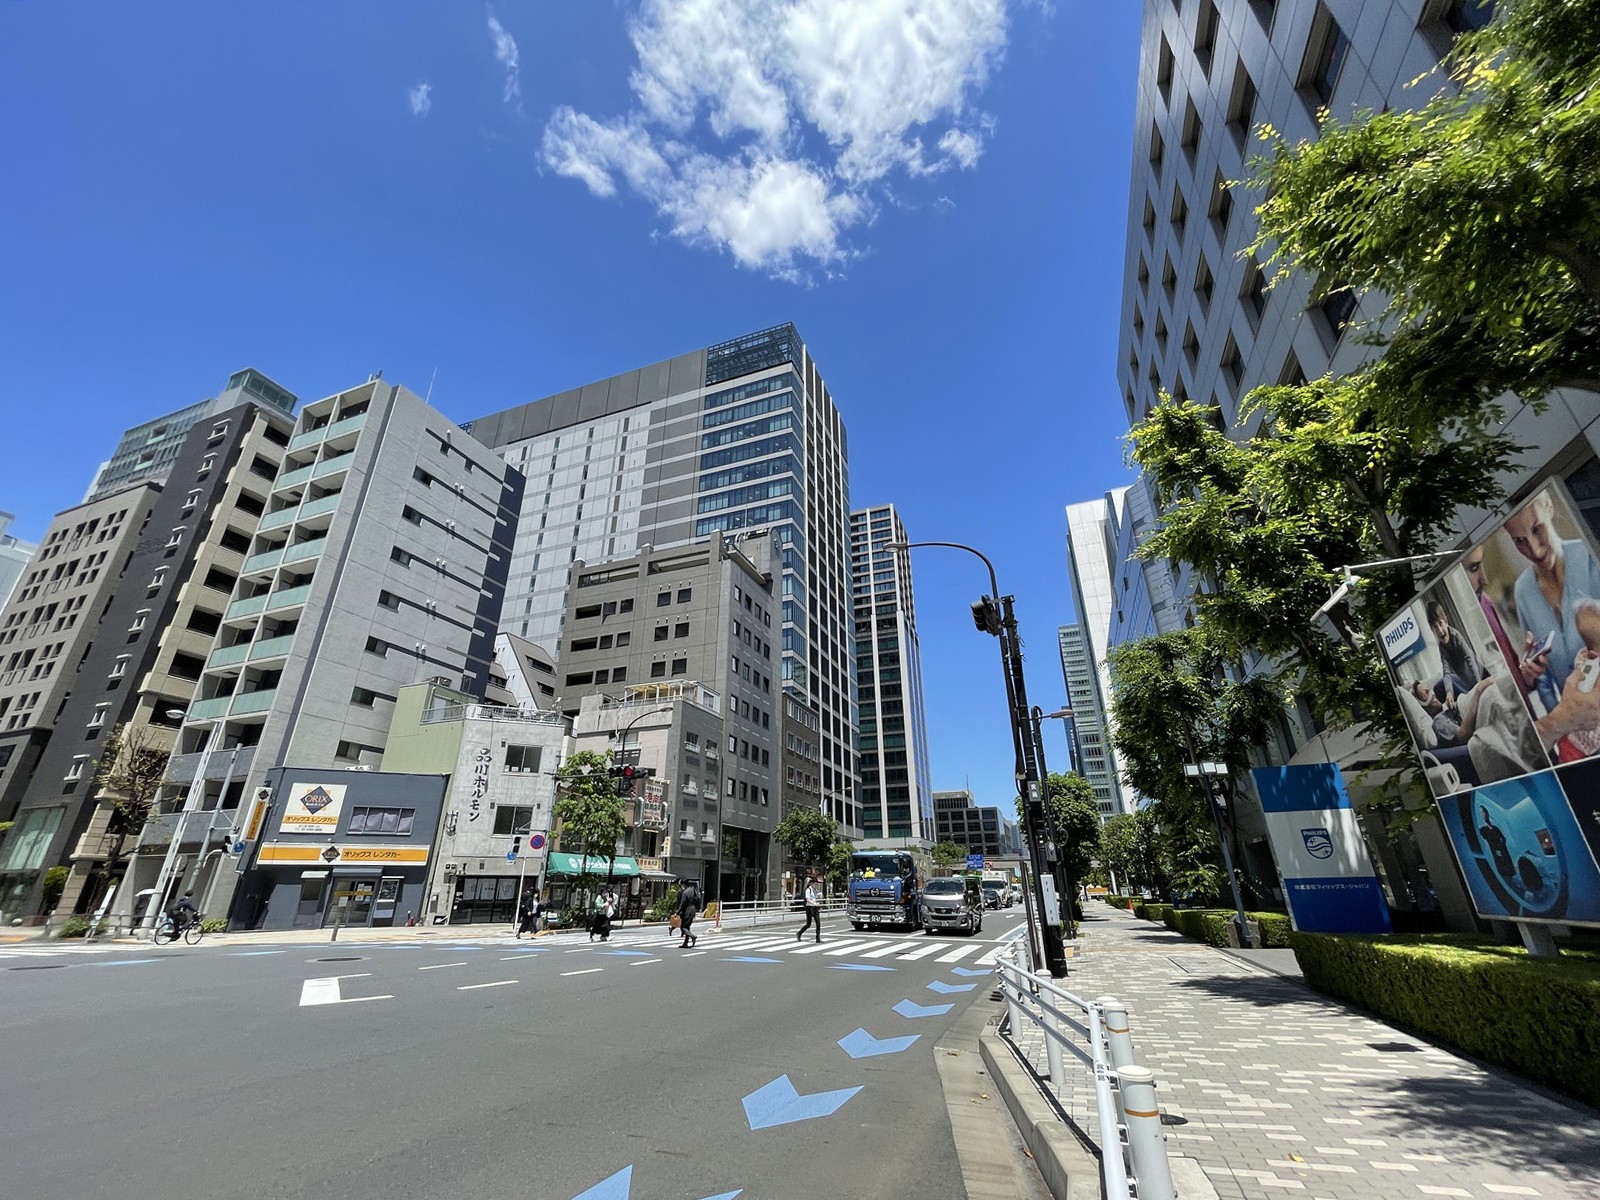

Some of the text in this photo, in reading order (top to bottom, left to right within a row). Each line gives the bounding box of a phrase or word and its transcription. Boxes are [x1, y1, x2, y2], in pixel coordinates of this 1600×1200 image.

[1385, 617, 1414, 647] PHILIPS
[304, 794, 328, 803] ORIX
[469, 748, 492, 822] 品川ホルモン
